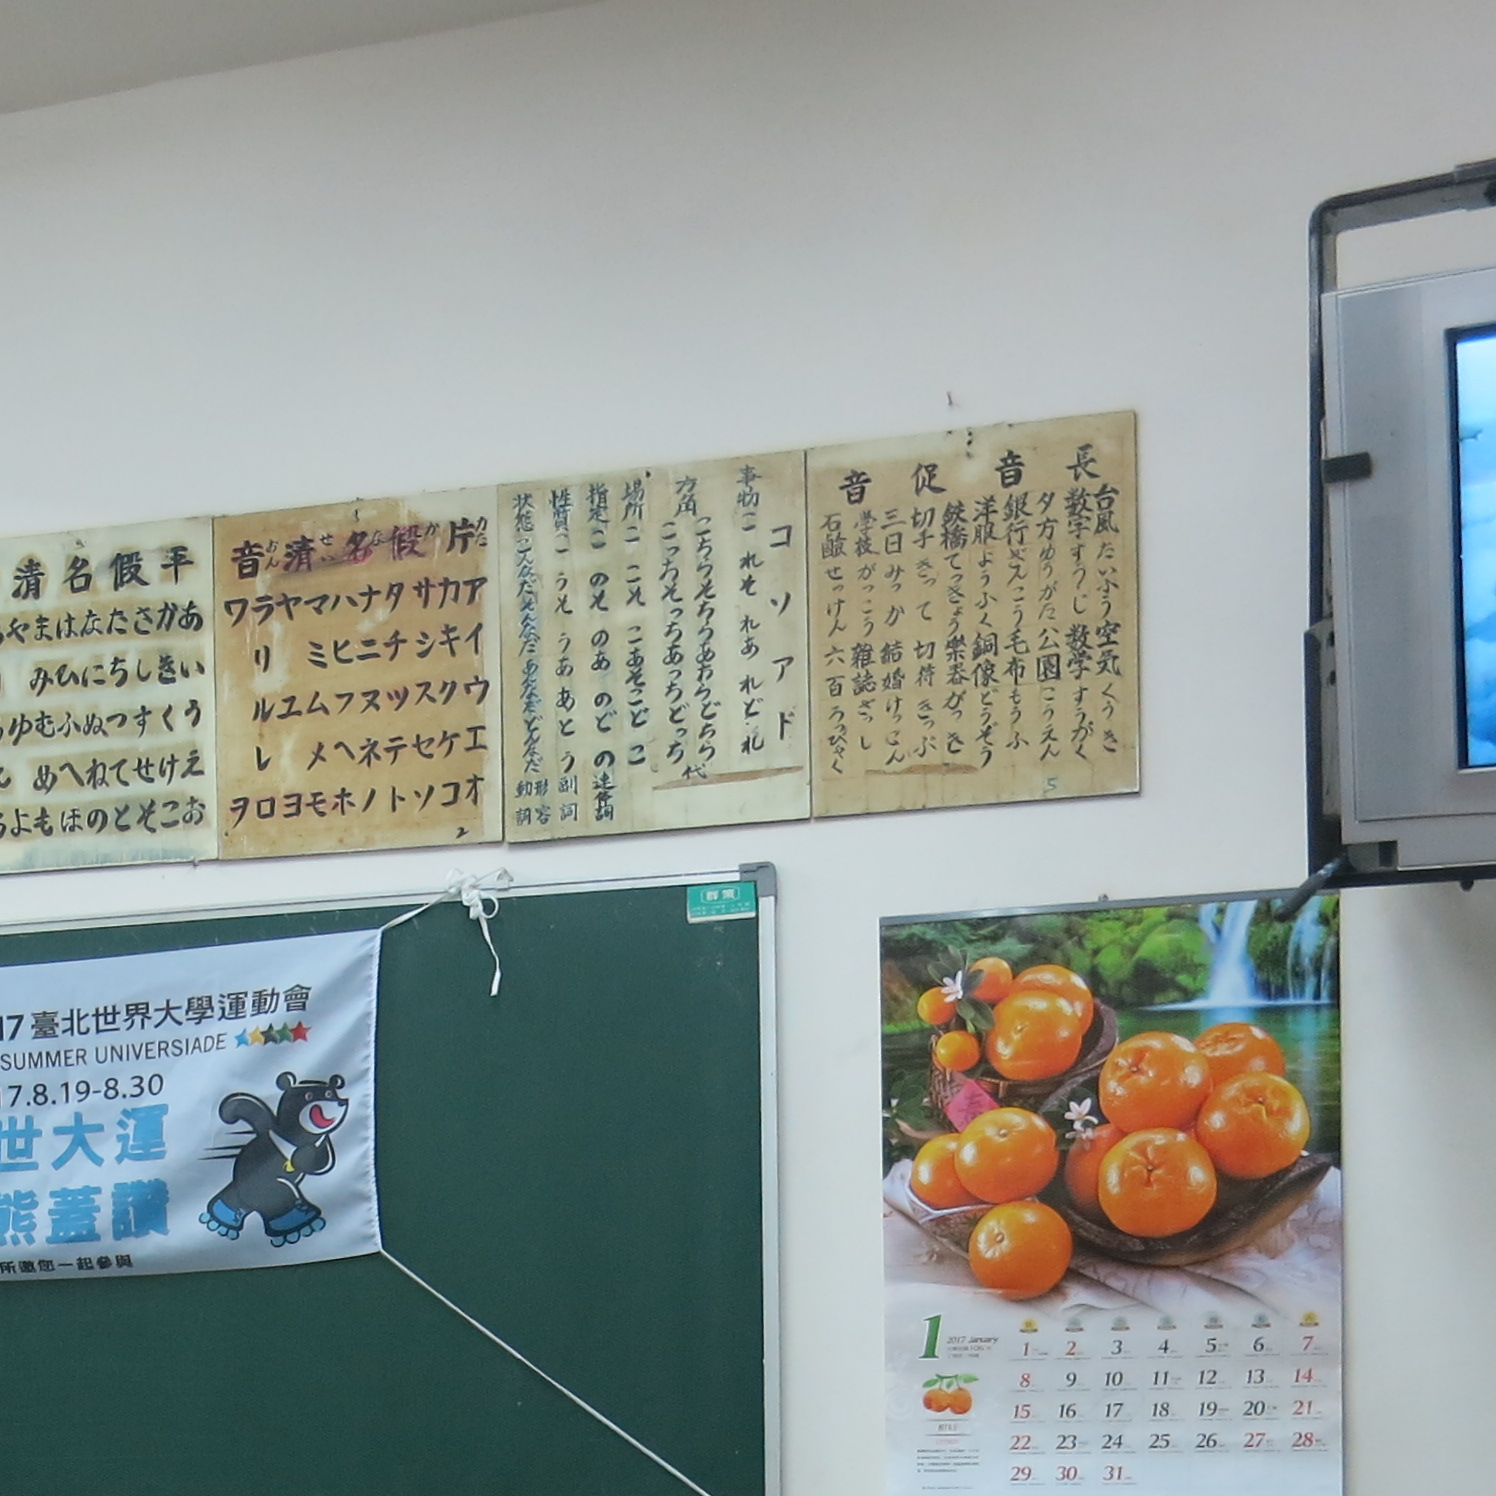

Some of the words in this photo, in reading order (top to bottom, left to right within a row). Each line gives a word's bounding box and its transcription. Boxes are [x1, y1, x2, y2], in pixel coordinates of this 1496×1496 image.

[30, 983, 312, 1042] 臺北世界大學運動會
[0, 1048, 88, 1072] SUMMER
[95, 1032, 227, 1066] UNIVERSIADE
[918, 1314, 942, 1359] 1
[1023, 1342, 1030, 1356] 1
[1065, 1341, 1077, 1356] 2
[1111, 1339, 1123, 1355] 3
[1158, 1339, 1169, 1354] 4
[1206, 1338, 1217, 1353] 5
[1253, 1336, 1265, 1352] 6
[1303, 1336, 1314, 1351] 7
[1020, 1373, 1031, 1388] 8
[1066, 1372, 1077, 1387] 9
[1105, 1371, 1123, 1386] 10
[1153, 1371, 1169, 1385] 11
[1199, 1370, 1217, 1384] 12
[1247, 1369, 1265, 1384] 13
[1294, 1368, 1313, 1383] 14
[1014, 1404, 1031, 1419] 15
[1059, 1404, 1077, 1419] 16
[1105, 1403, 1124, 1418] 17
[1152, 1402, 1170, 1417] 18
[1199, 1401, 1218, 1417] 19
[1243, 1400, 1266, 1416] 20
[1292, 1400, 1312, 1415] 21
[1010, 1435, 1031, 1450] 22
[1056, 1435, 1077, 1450] 23
[1101, 1434, 1123, 1449] 24
[1148, 1433, 1170, 1449] 25
[1195, 1433, 1218, 1448] 26
[1243, 1433, 1266, 1448] 27
[1291, 1432, 1314, 1448] 28
[1010, 1466, 1032, 1481] 29
[1056, 1466, 1077, 1481] 30
[1103, 1465, 1123, 1481] 31
